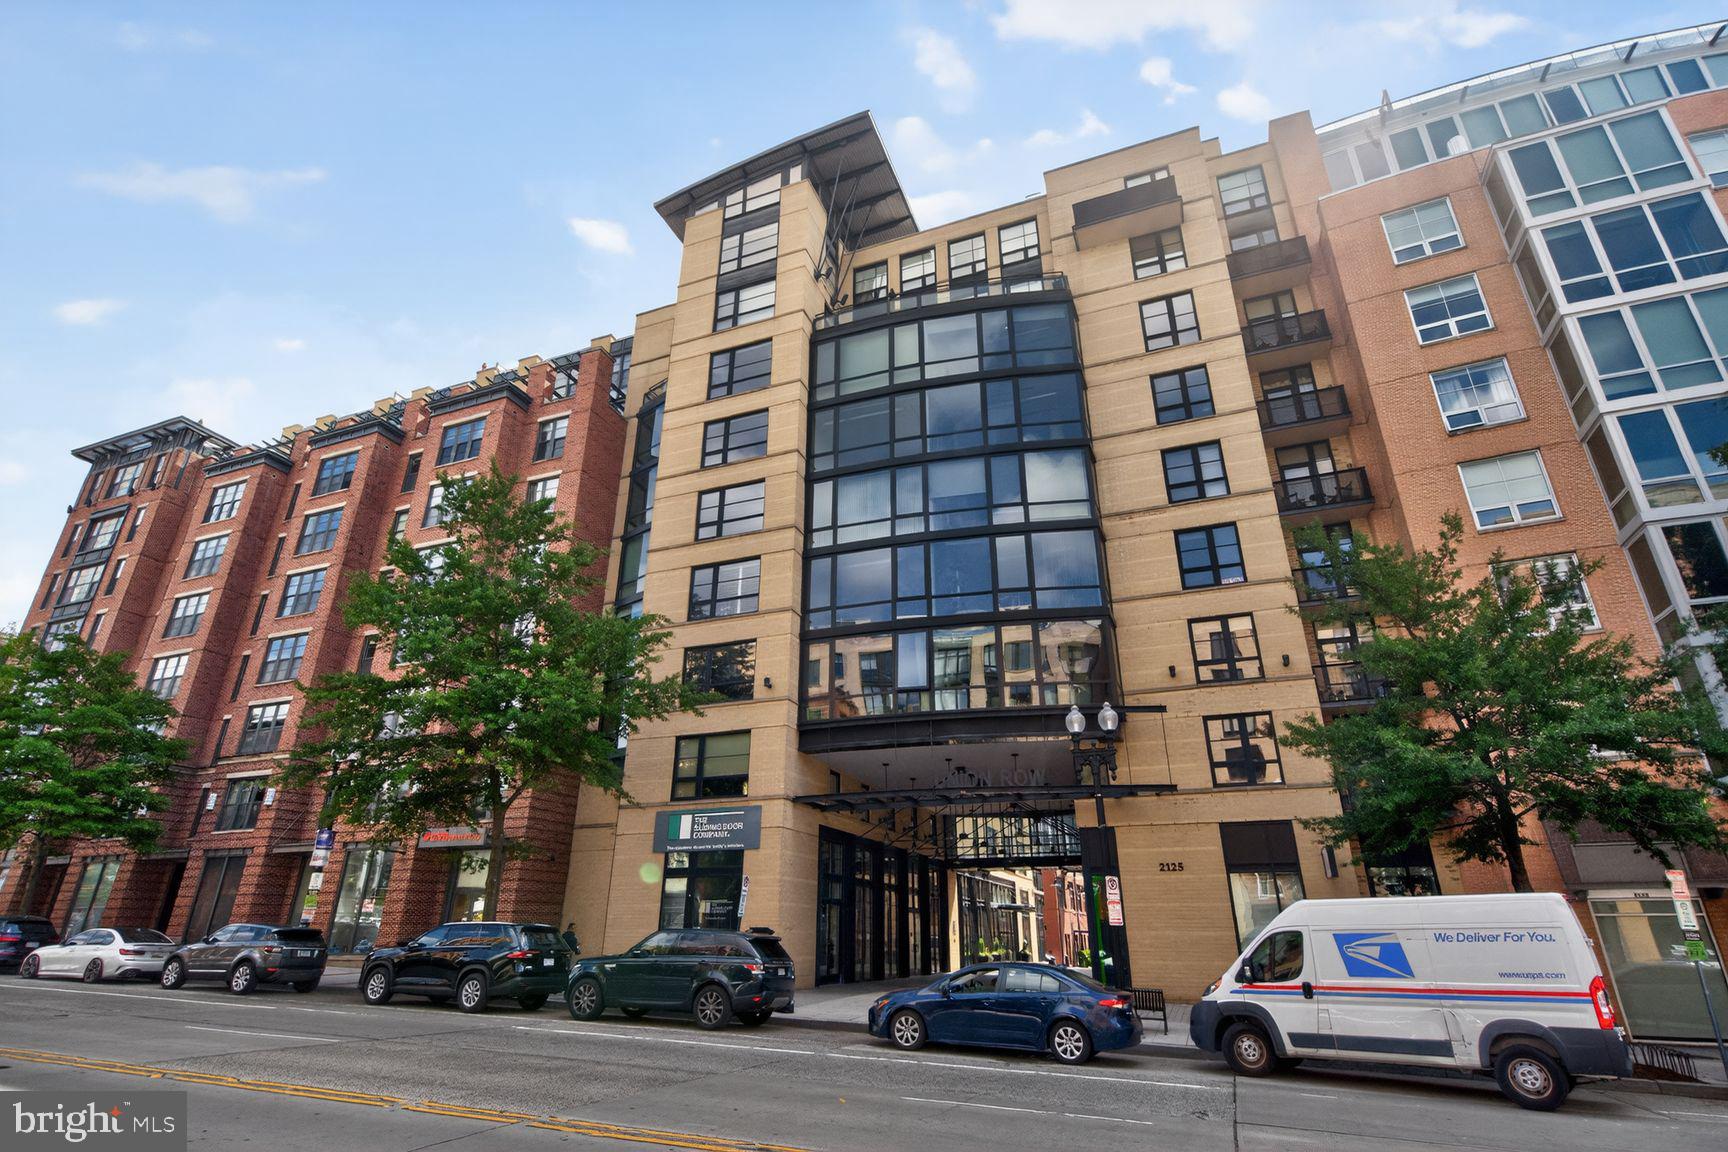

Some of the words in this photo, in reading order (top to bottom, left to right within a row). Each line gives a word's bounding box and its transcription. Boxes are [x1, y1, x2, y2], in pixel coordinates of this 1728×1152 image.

[1001, 768, 1046, 787] ROW
[1159, 862, 1185, 872] 2125
[1433, 932, 1454, 943] We
[1456, 932, 1501, 943] Deliver
[1503, 931, 1525, 942] For
[1526, 931, 1556, 943] You.
